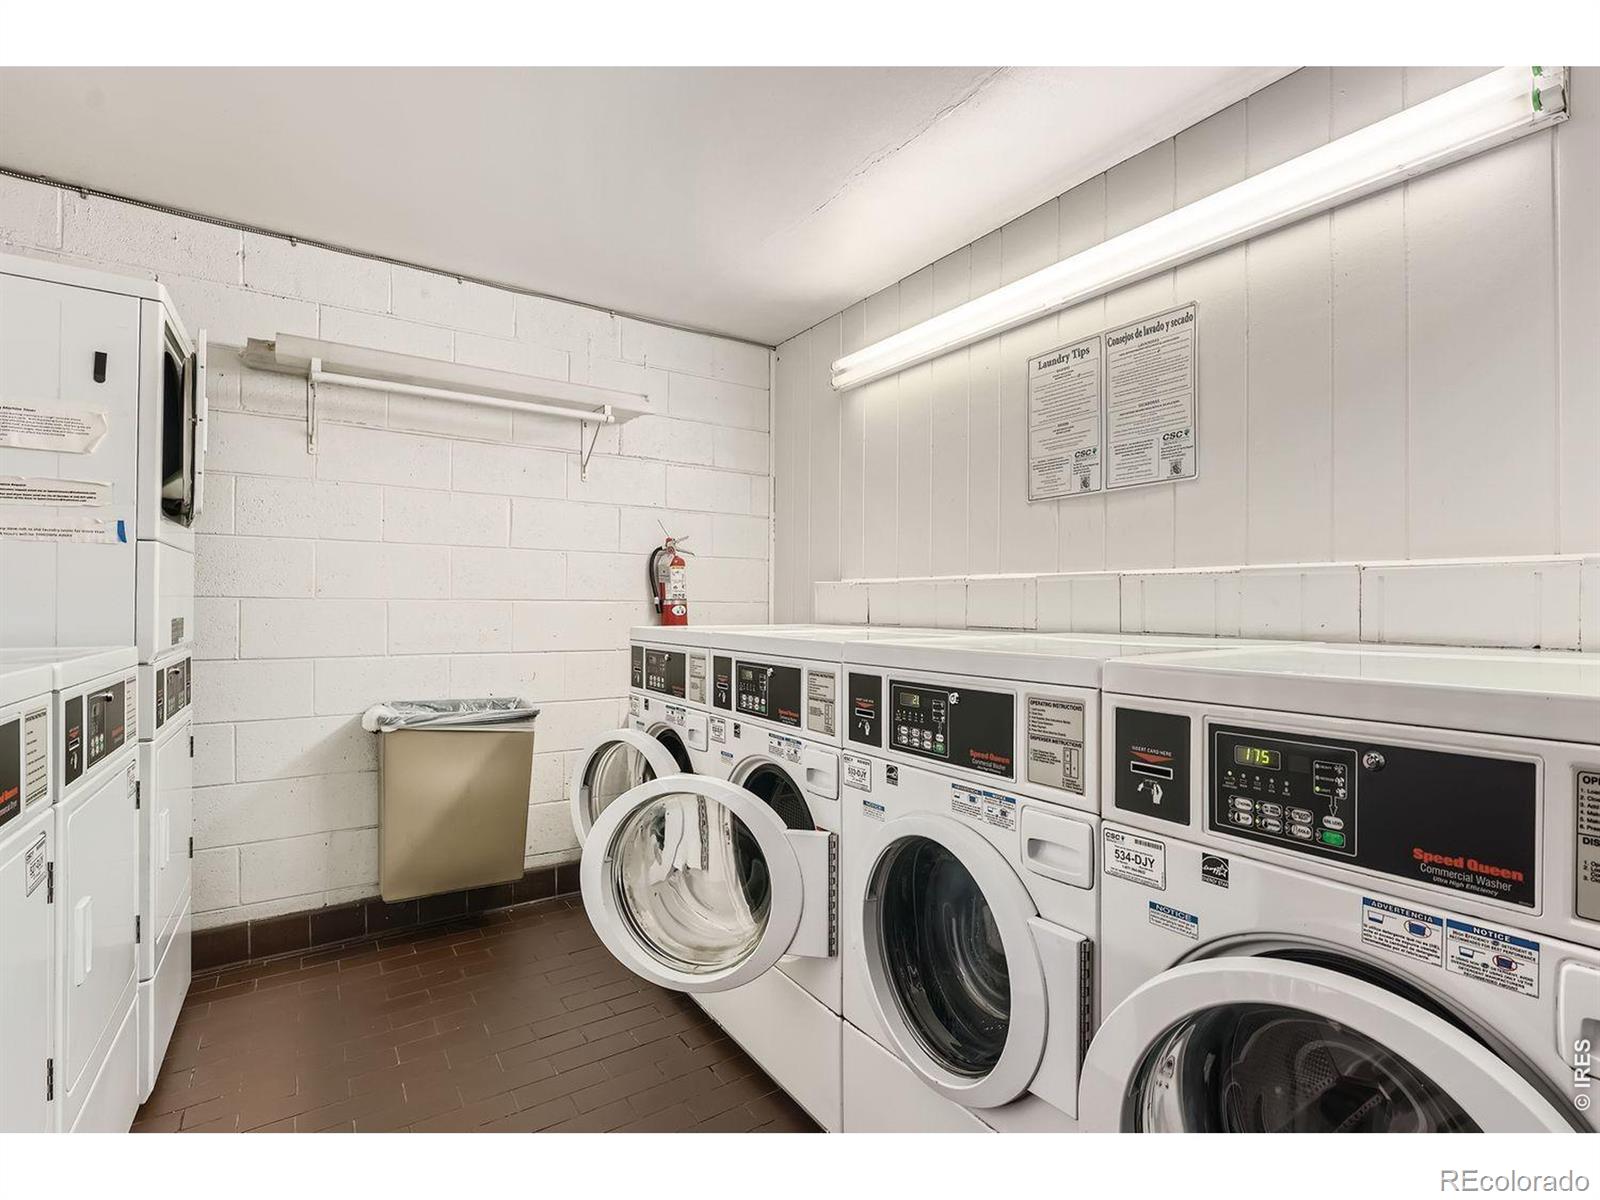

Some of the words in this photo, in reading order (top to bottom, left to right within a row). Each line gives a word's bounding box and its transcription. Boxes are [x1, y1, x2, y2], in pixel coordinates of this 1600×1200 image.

[1107, 332, 1134, 348] Consejos
[1134, 328, 1143, 339] de
[1144, 322, 1165, 336] lavado
[1166, 319, 1170, 332] y
[1170, 312, 1194, 328] secado
[1038, 353, 1070, 370] Laundry
[1072, 346, 1090, 361] Tips
[1162, 430, 1184, 442] CSC
[1074, 448, 1092, 458] CSC
[1246, 748, 1270, 764] 175
[1582, 776, 1600, 785] OP
[1114, 848, 1156, 868] 534-DJY
[1412, 847, 1464, 869] Speed
[1466, 858, 1524, 882] Queen
[1420, 862, 1473, 882] Commercial
[1476, 874, 1512, 892] Washer
[1432, 876, 1448, 885] Ultra
[1449, 879, 1464, 888] High
[1466, 884, 1499, 896] Efficiency
[1155, 904, 1192, 921] NOTICE
[1370, 900, 1434, 922] ADVERTENCIA
[1472, 926, 1511, 943] NOTICE
